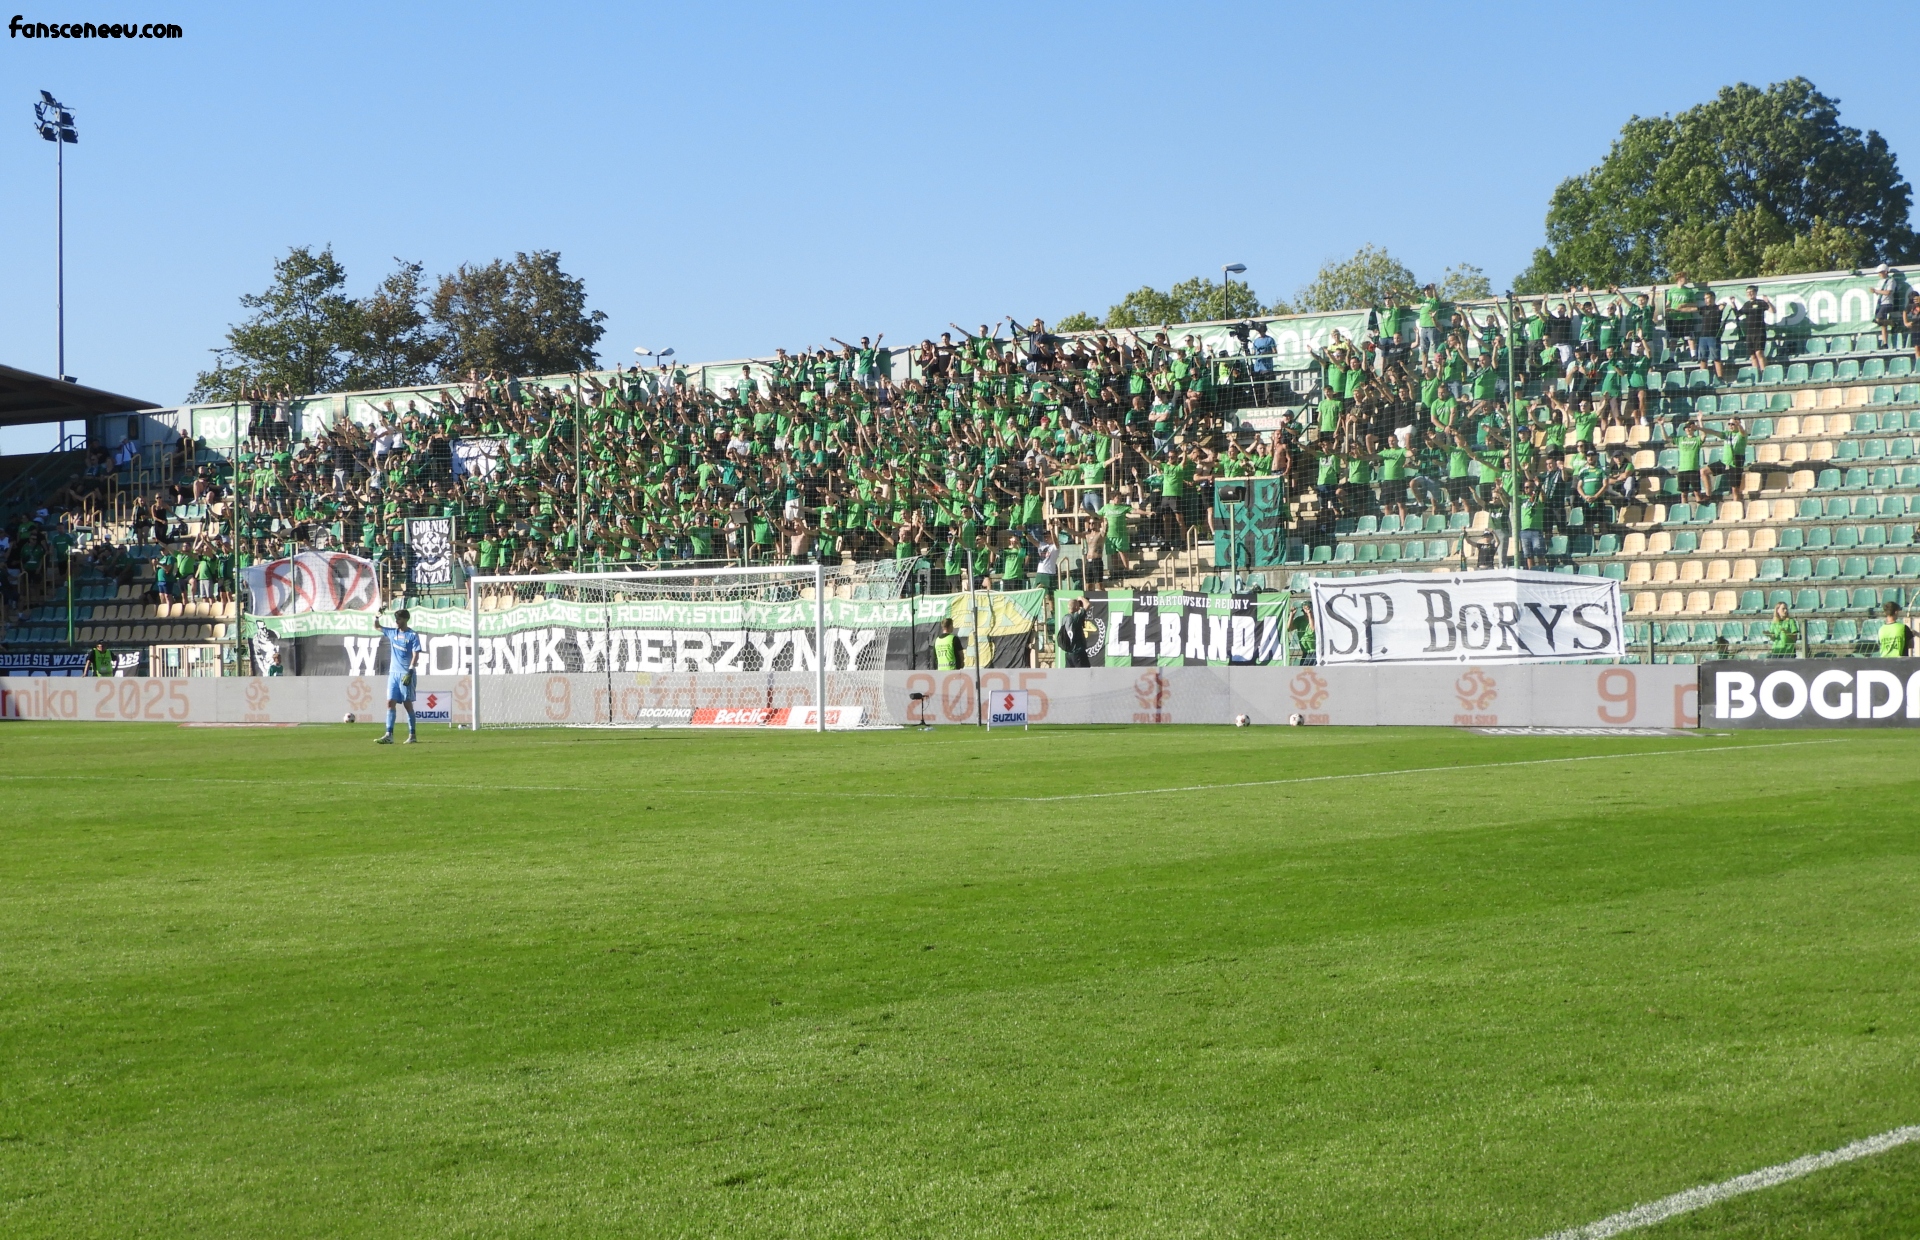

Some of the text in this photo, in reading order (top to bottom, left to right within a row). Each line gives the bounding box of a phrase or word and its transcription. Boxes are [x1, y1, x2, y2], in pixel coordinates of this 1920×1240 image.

[1140, 595, 1249, 610] LUBARTOWSKIE REJONY
[1417, 589, 1612, 655] BORYS
[344, 636, 381, 676] W
[576, 628, 876, 673] WIERZYMY
[95, 680, 190, 720] 2025
[1597, 668, 1637, 724] 9
[415, 711, 449, 719] SUZUKI
[639, 707, 692, 718] BOGDANKA
[713, 707, 768, 724] Betclic
[992, 713, 1026, 723] SUZUKI
